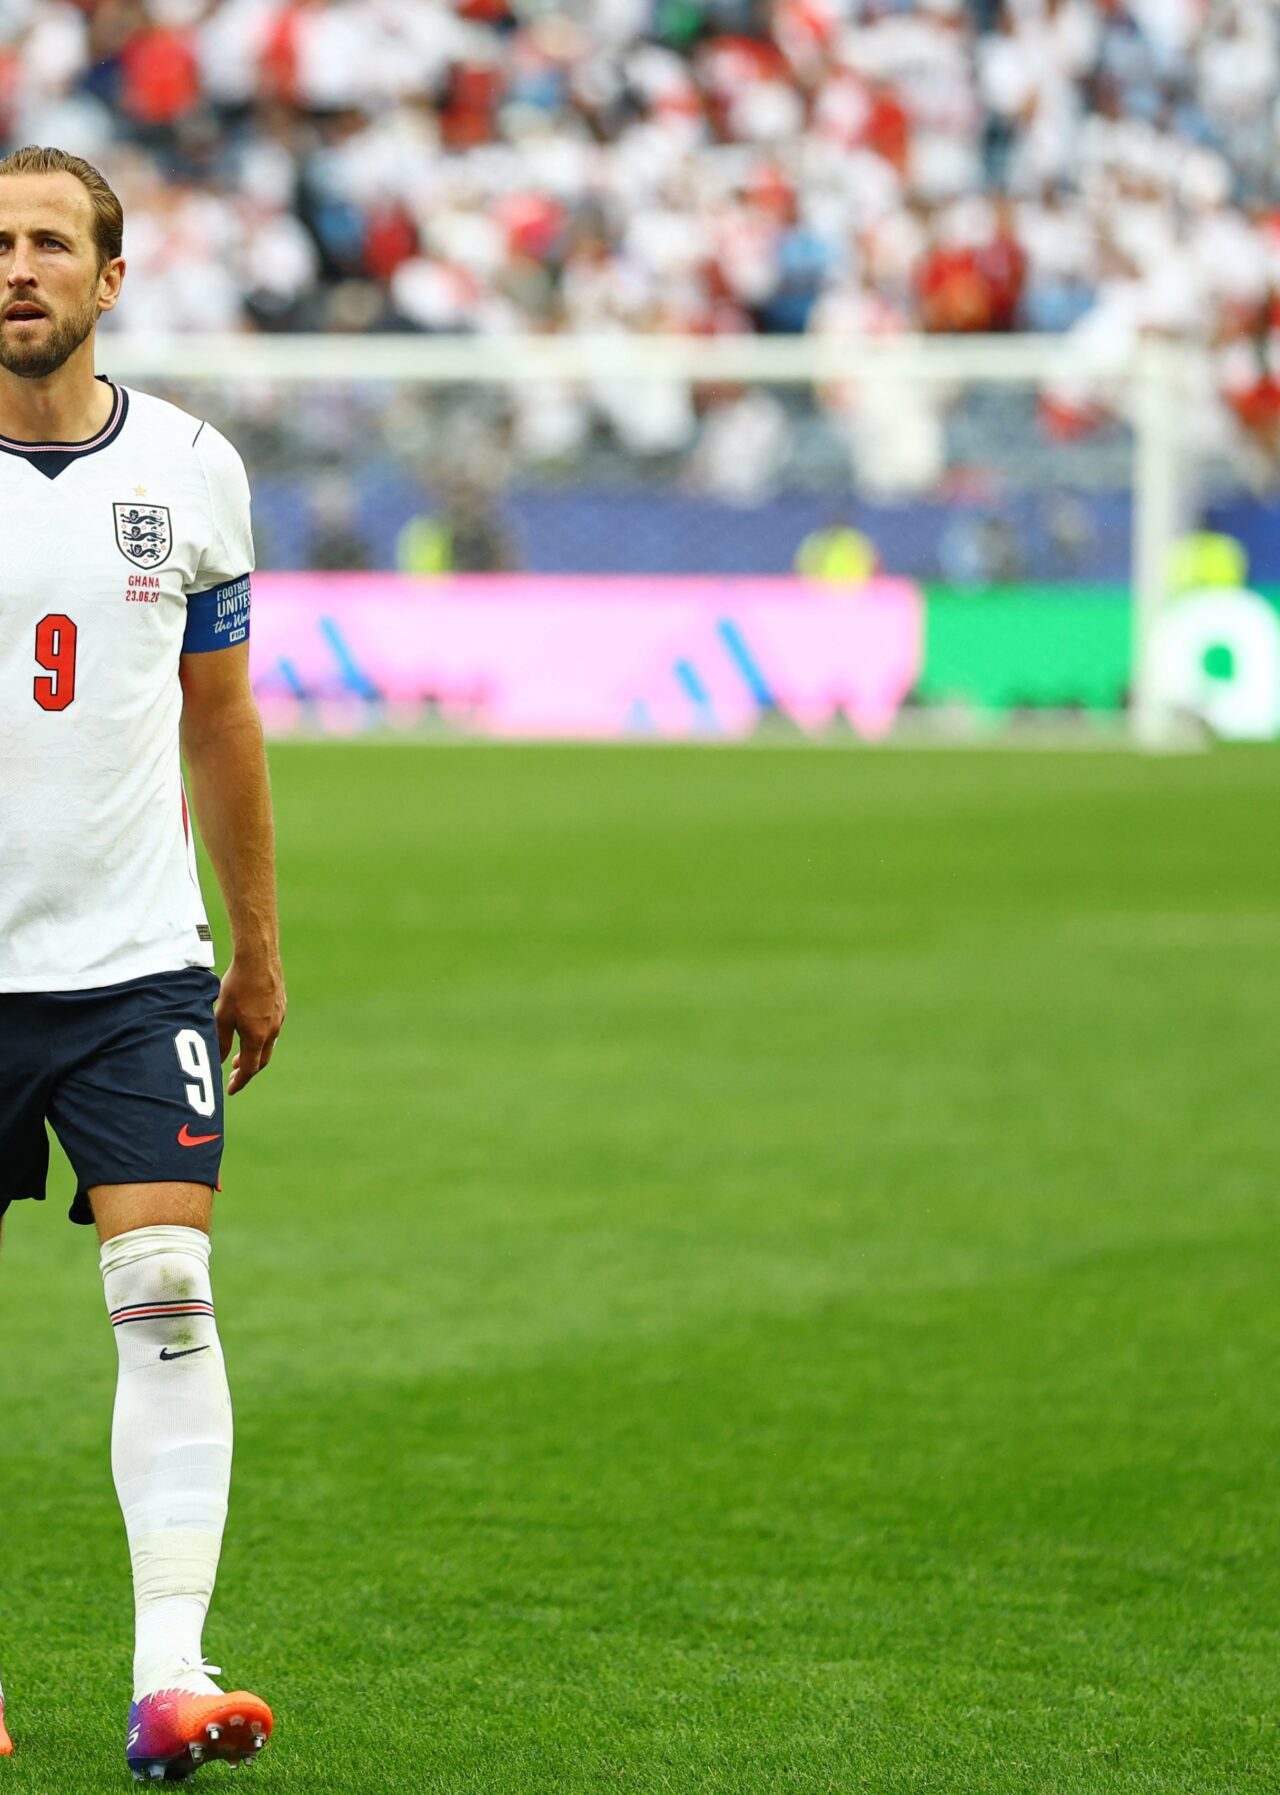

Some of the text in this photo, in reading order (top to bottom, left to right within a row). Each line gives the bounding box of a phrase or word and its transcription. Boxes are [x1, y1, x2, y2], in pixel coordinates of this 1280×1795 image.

[128, 575, 160, 588] GHANA
[213, 618, 232, 634] the
[231, 629, 244, 641] FIFA
[33, 613, 77, 711] 9
[173, 1028, 216, 1119] 9
